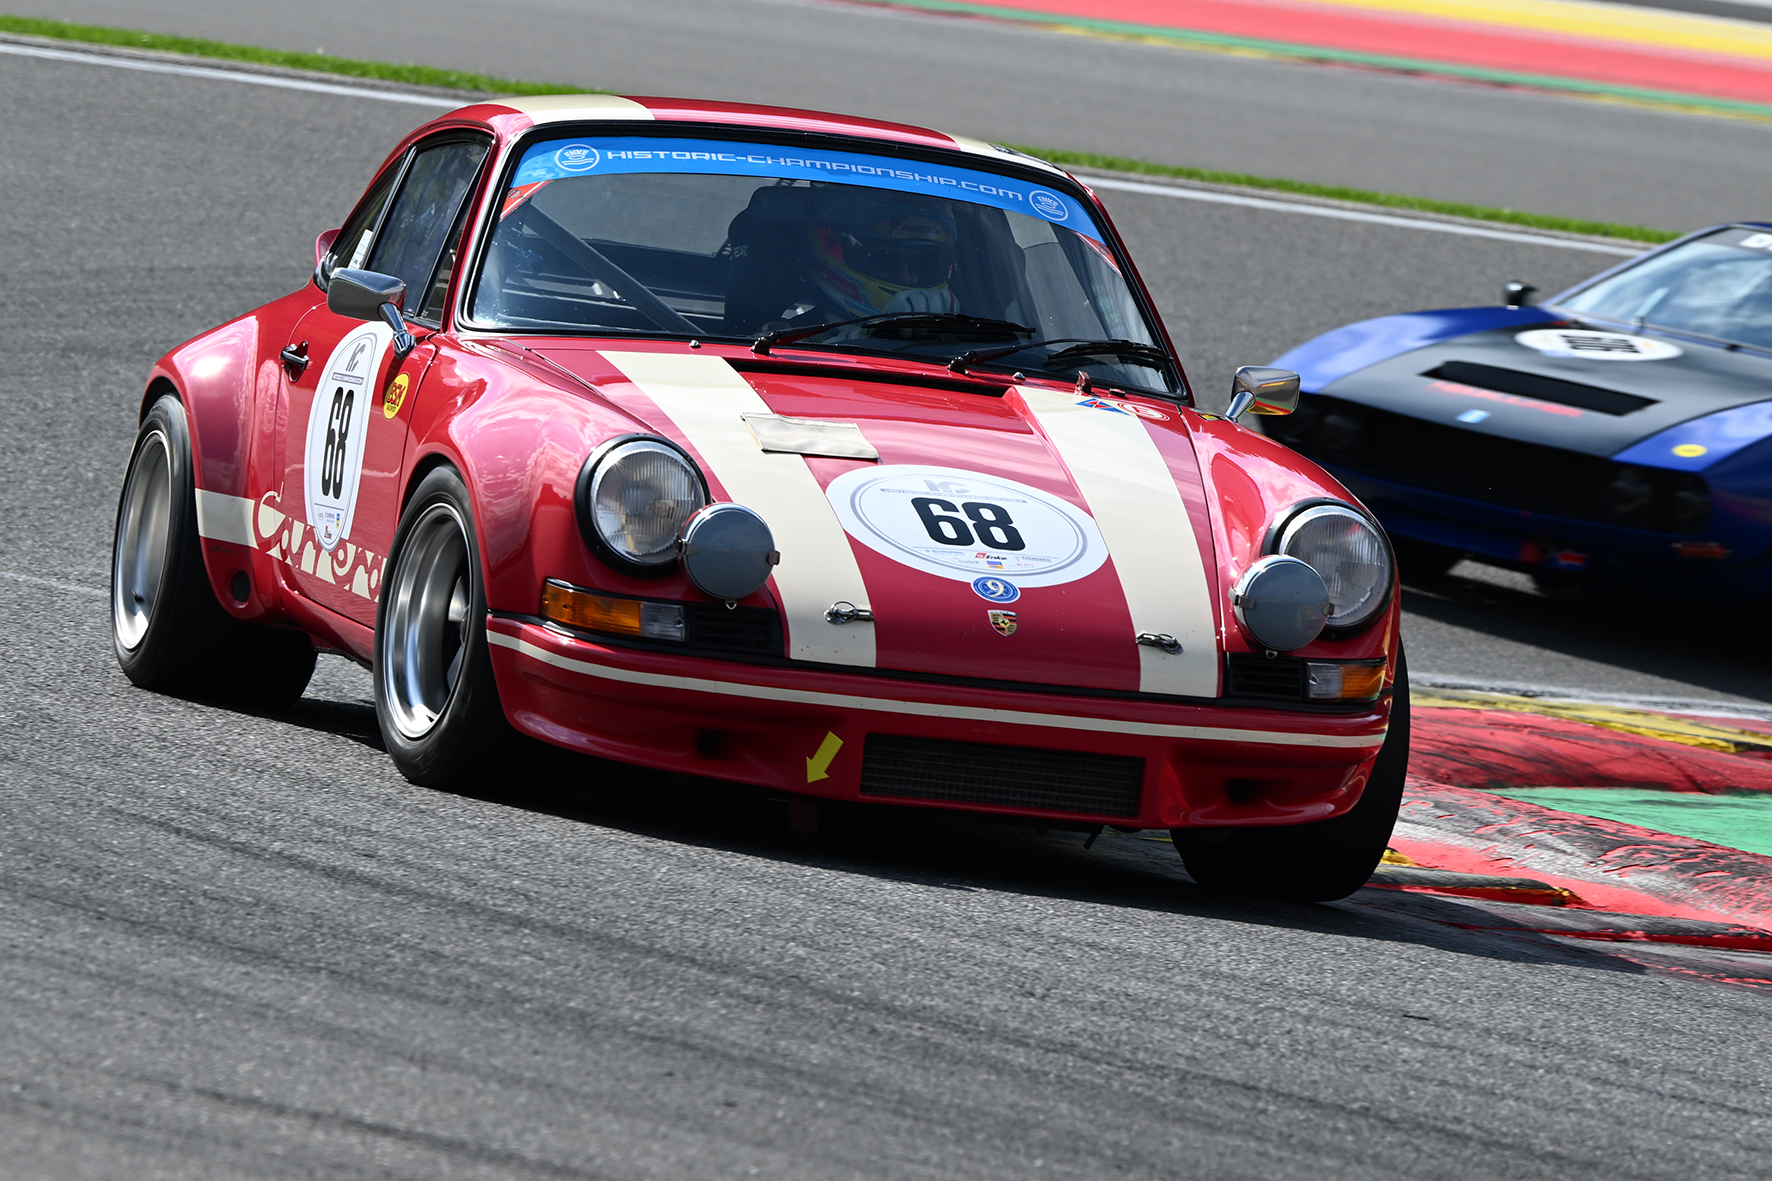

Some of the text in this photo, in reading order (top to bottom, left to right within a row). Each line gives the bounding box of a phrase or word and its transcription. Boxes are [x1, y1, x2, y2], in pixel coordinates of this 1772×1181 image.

[321, 386, 355, 500] 68
[910, 496, 1026, 551] 68
[986, 579, 1005, 598] 9
